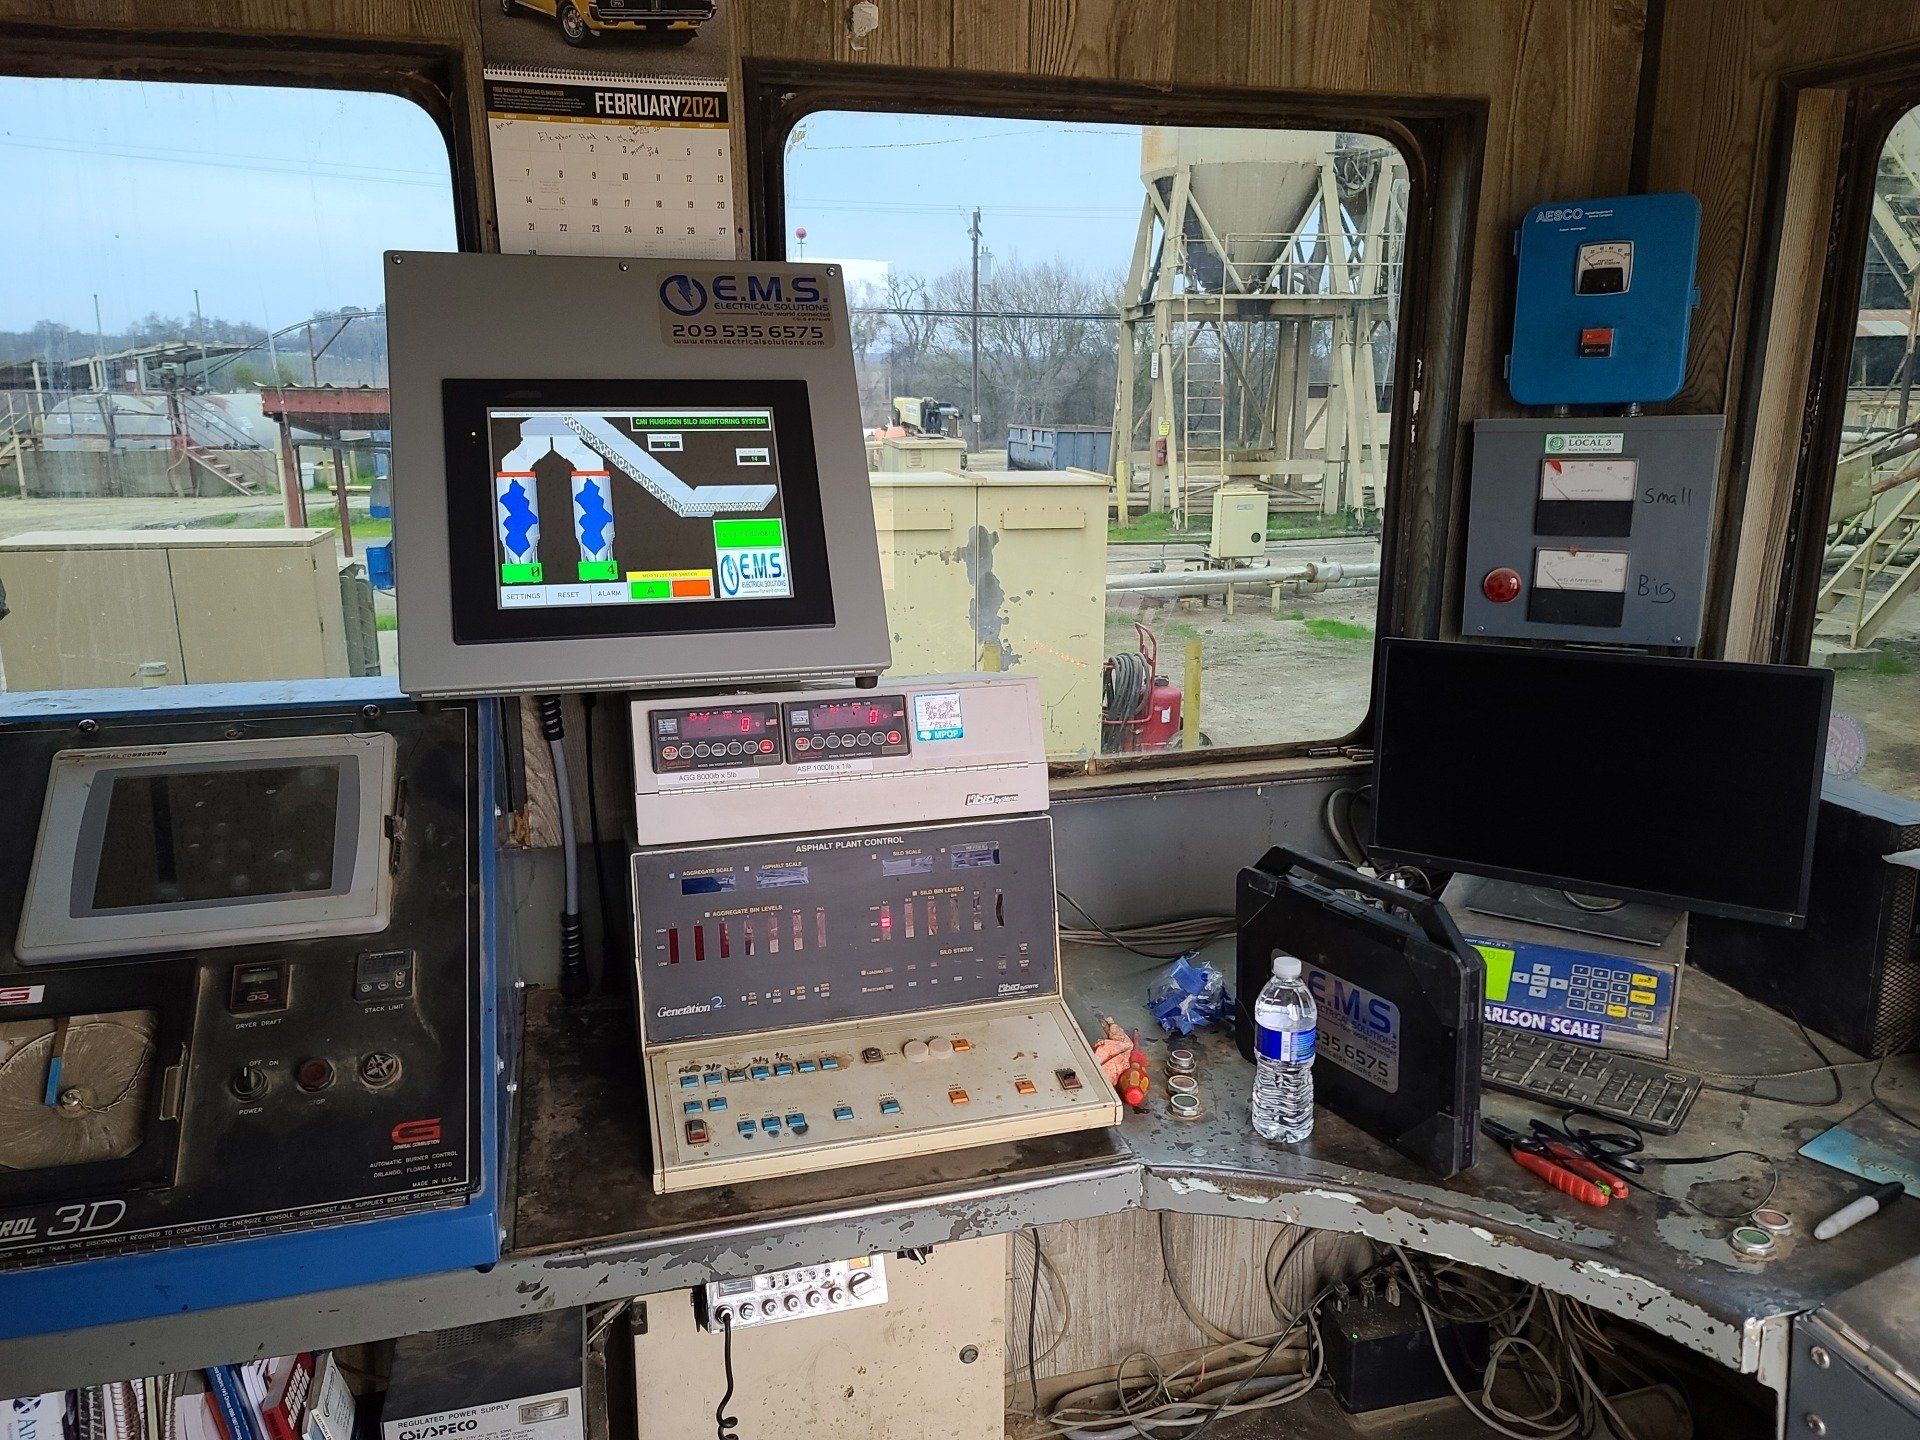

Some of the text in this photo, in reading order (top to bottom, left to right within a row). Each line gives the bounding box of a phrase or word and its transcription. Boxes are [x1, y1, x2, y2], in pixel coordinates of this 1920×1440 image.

[595, 92, 681, 117] FEBRUARY
[682, 96, 720, 118] 2021
[590, 145, 595, 153] 2
[623, 146, 627, 154] 3
[655, 147, 659, 155] 4
[687, 148, 691, 156] 5
[559, 170, 564, 178] 8
[592, 172, 596, 180] 9
[622, 173, 629, 181] 10
[657, 174, 661, 182] 11
[686, 175, 692, 183] 12
[718, 175, 724, 183] 13
[592, 199, 598, 207] 16
[625, 199, 630, 207] 17
[656, 201, 662, 209] 18
[688, 201, 694, 209] 19
[717, 201, 725, 209] 20
[1536, 208, 1584, 223] AESCO
[560, 224, 568, 232] 22
[625, 226, 632, 234] 24
[688, 227, 695, 235] 26
[719, 227, 726, 235] 27
[712, 276, 829, 303] E.M.S.
[714, 303, 830, 312] ELECTRICAL SOLUTIONS
[673, 325, 824, 339] 209 535 6575
[674, 338, 825, 347] www.emselectricalsolutions.com
[1606, 439, 1612, 447] 3
[1645, 488, 1692, 506] Small
[607, 564, 615, 575] 4
[740, 553, 786, 579] E.M.S.
[647, 586, 656, 595] A
[1637, 575, 1677, 604] Big
[934, 730, 959, 739] MPQP
[122, 751, 168, 759] COMBUSTION
[798, 765, 812, 773] ASP
[814, 764, 835, 772] 1000lb
[679, 774, 696, 782] AGG
[696, 773, 721, 781] 8000lb
[795, 836, 905, 854] ASPHALT PLANT CONTROL
[682, 869, 715, 877] AGGREGATE
[713, 909, 749, 917] AGGREGATE
[1020, 983, 1040, 991] systems
[364, 1003, 405, 1014] STACK LIMIT
[657, 1004, 712, 1019] Generation
[235, 1018, 282, 1030] DRYER DRAFT
[1550, 1017, 1601, 1040] SCALE
[1345, 1045, 1389, 1078] 6575
[239, 1107, 263, 1116] POWER
[393, 1139, 441, 1151] GENERAL COMBUSTION
[370, 1151, 458, 1168] AUTOMATIC BURNER CONTROL
[374, 1170, 403, 1178] ORLANDO,
[407, 1166, 431, 1174] FLORIDA
[27, 1247, 46, 1255] MORE
[49, 1244, 66, 1253] THAN
[70, 1242, 82, 1250] ONE
[86, 1236, 126, 1248] DISCONNECT
[130, 1231, 161, 1241] REQUIRED
[176, 1224, 216, 1235] COMPLETELY
[219, 1216, 262, 1229] DE-ENERGIZE
[300, 1205, 338, 1217] DISCONNECT
[355, 1198, 384, 1209] SUPPLIES
[387, 1194, 410, 1204] BEFORE
[47, 1200, 127, 1237] 3D
[398, 1404, 510, 1429] REGULATED POWER SUPPLY
